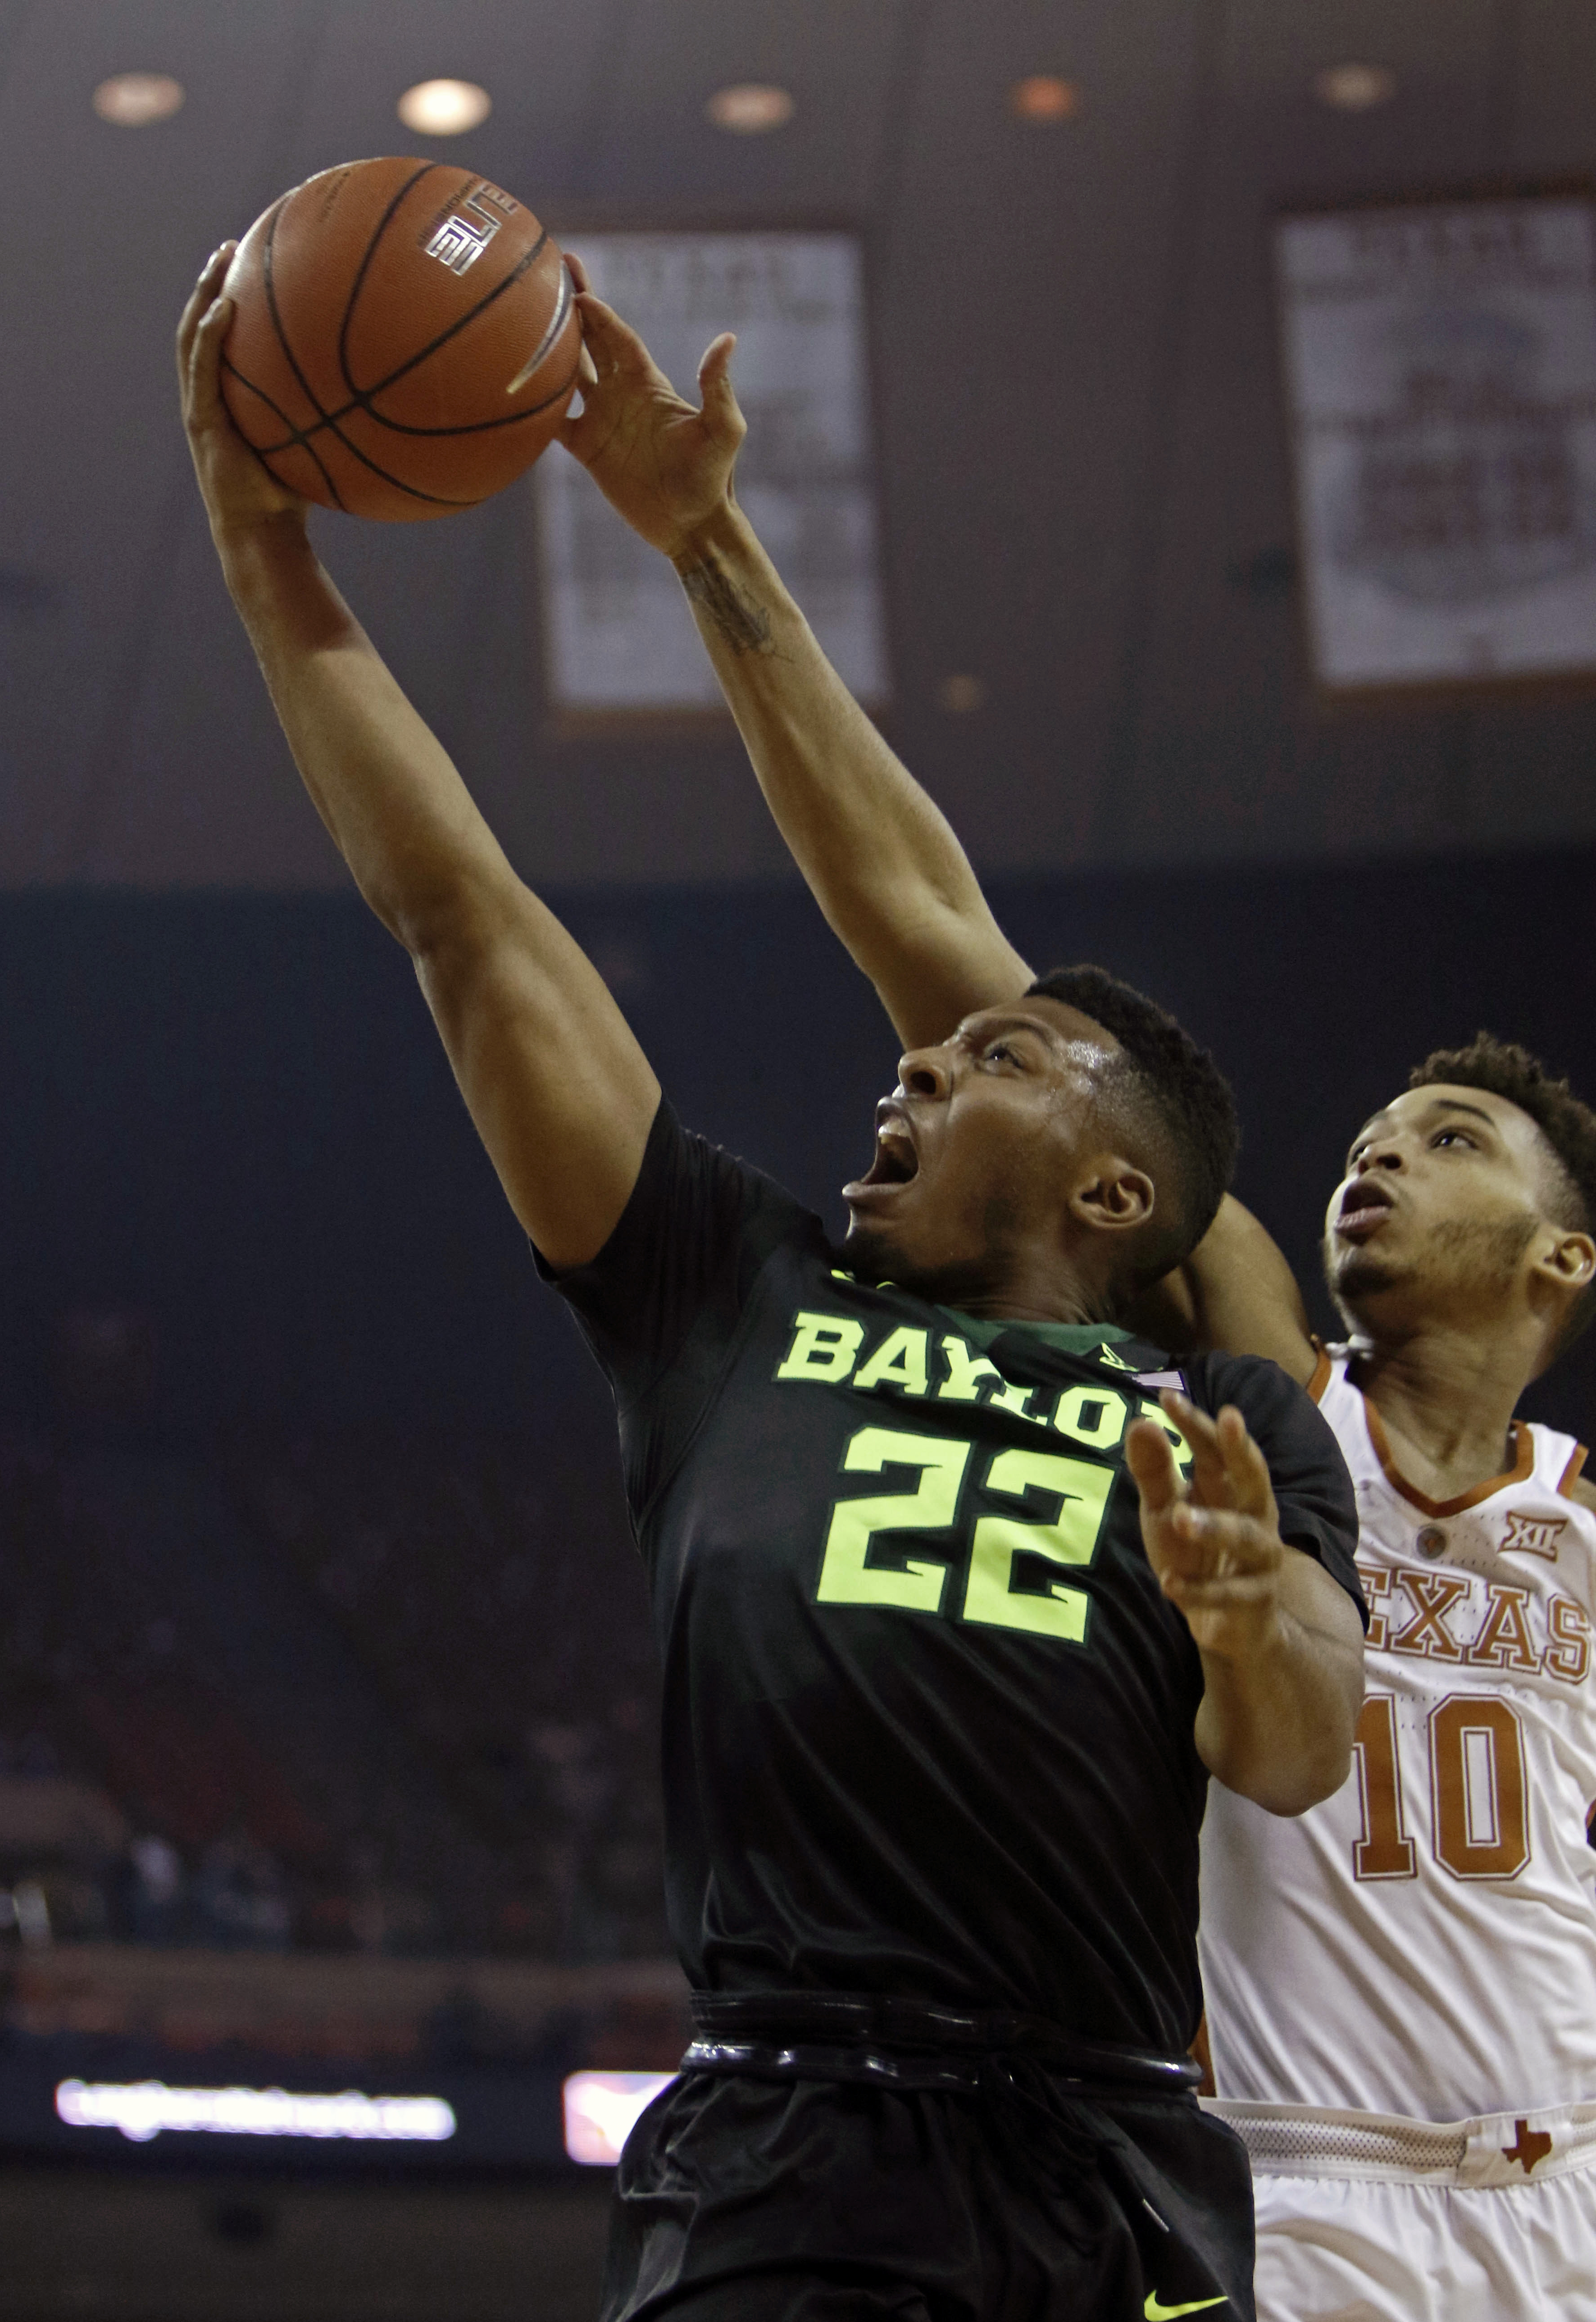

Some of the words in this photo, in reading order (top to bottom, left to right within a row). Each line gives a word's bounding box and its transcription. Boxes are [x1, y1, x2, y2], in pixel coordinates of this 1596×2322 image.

[816, 1427, 1116, 1644] 22
[1498, 1510, 1568, 1562] XII
[1357, 1563, 1591, 1685] EXAS
[1351, 1693, 1531, 1882] 10
